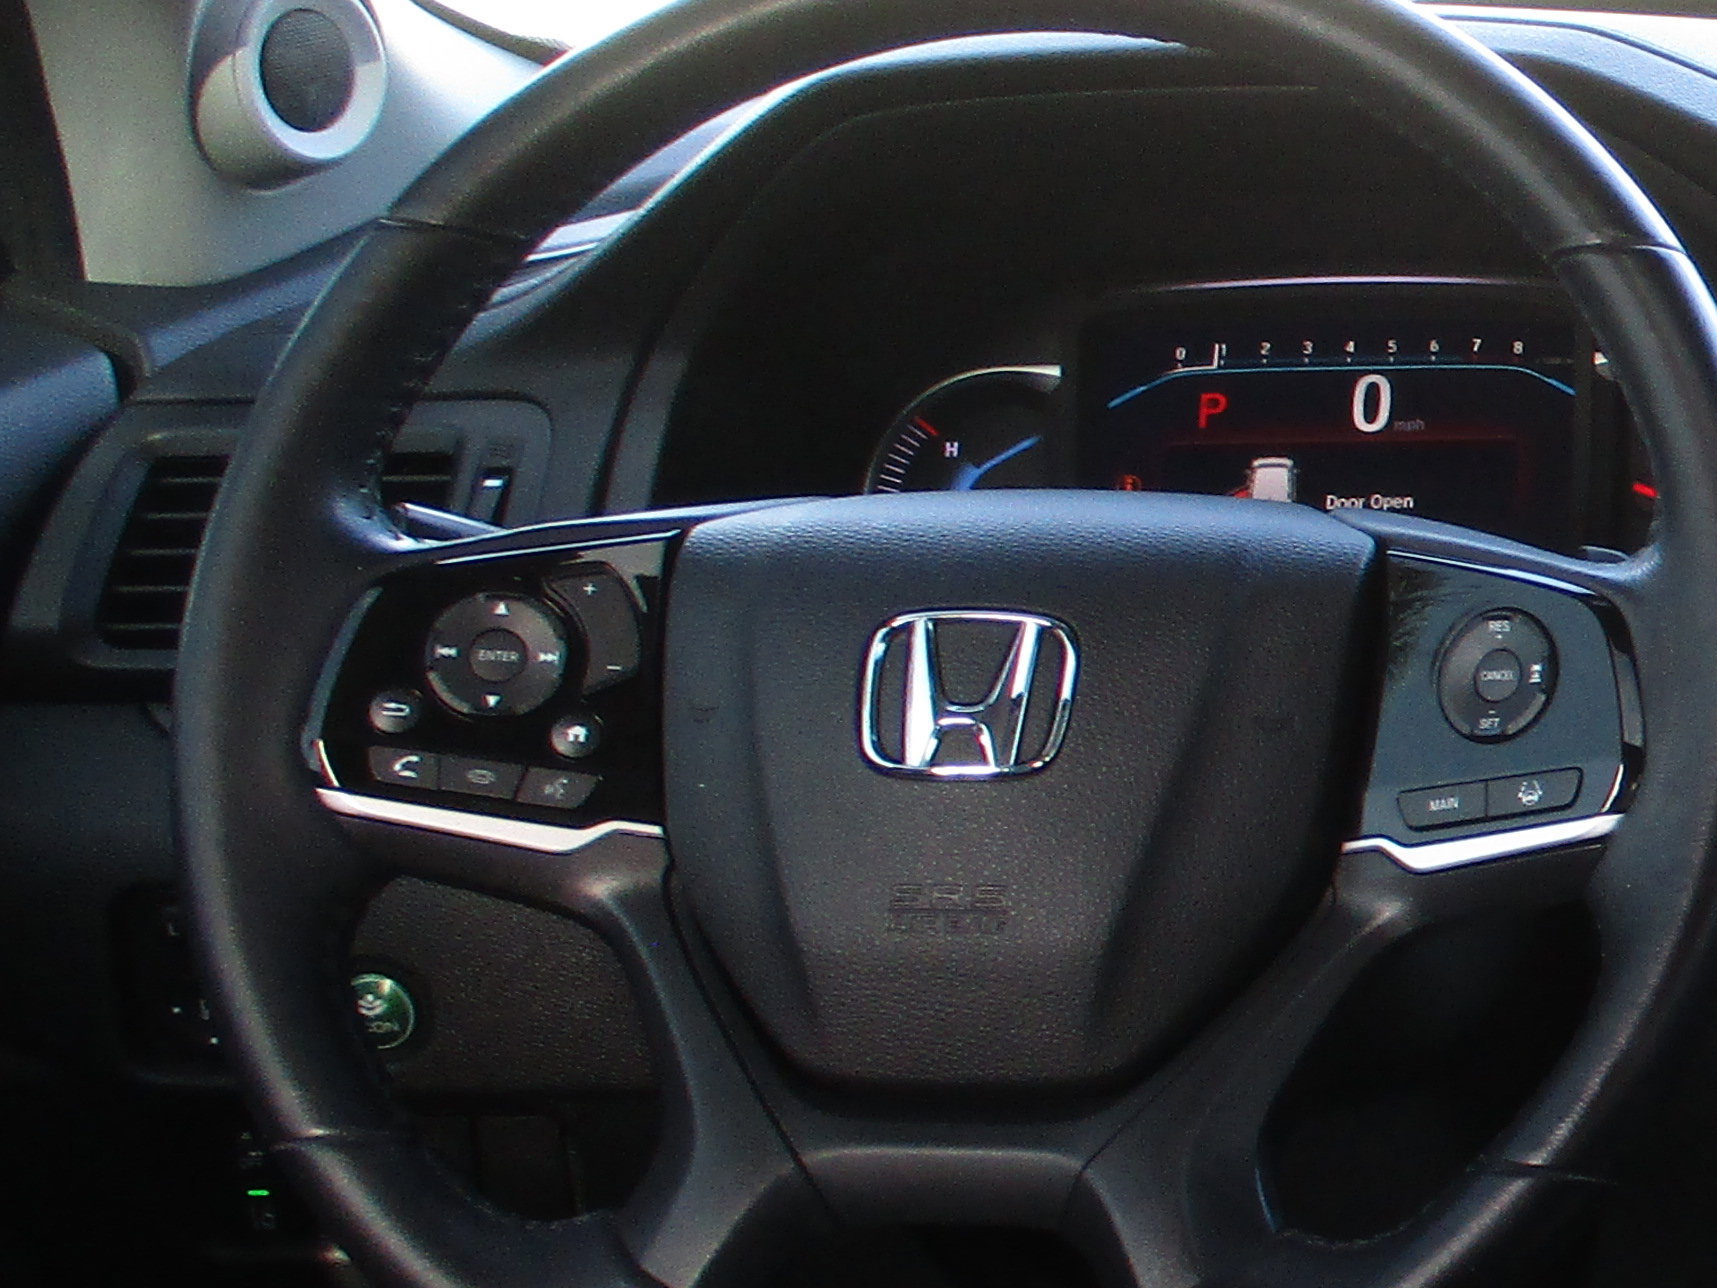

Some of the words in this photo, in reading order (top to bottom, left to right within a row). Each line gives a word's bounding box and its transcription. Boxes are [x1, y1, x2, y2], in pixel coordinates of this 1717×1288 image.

[1174, 346, 1187, 361] 0
[1260, 340, 1272, 355] 2
[1302, 340, 1313, 355] 3
[1343, 339, 1355, 354] 4
[1387, 339, 1398, 354] 5
[1429, 339, 1440, 353] 6
[1471, 338, 1482, 353] 7
[1512, 340, 1523, 355] 8
[1198, 392, 1229, 429] P
[1351, 373, 1393, 434] 0
[944, 441, 959, 458] H
[1325, 494, 1366, 510] Door
[1368, 493, 1414, 511] Open
[1487, 618, 1512, 632] RES
[1479, 717, 1500, 730] SET
